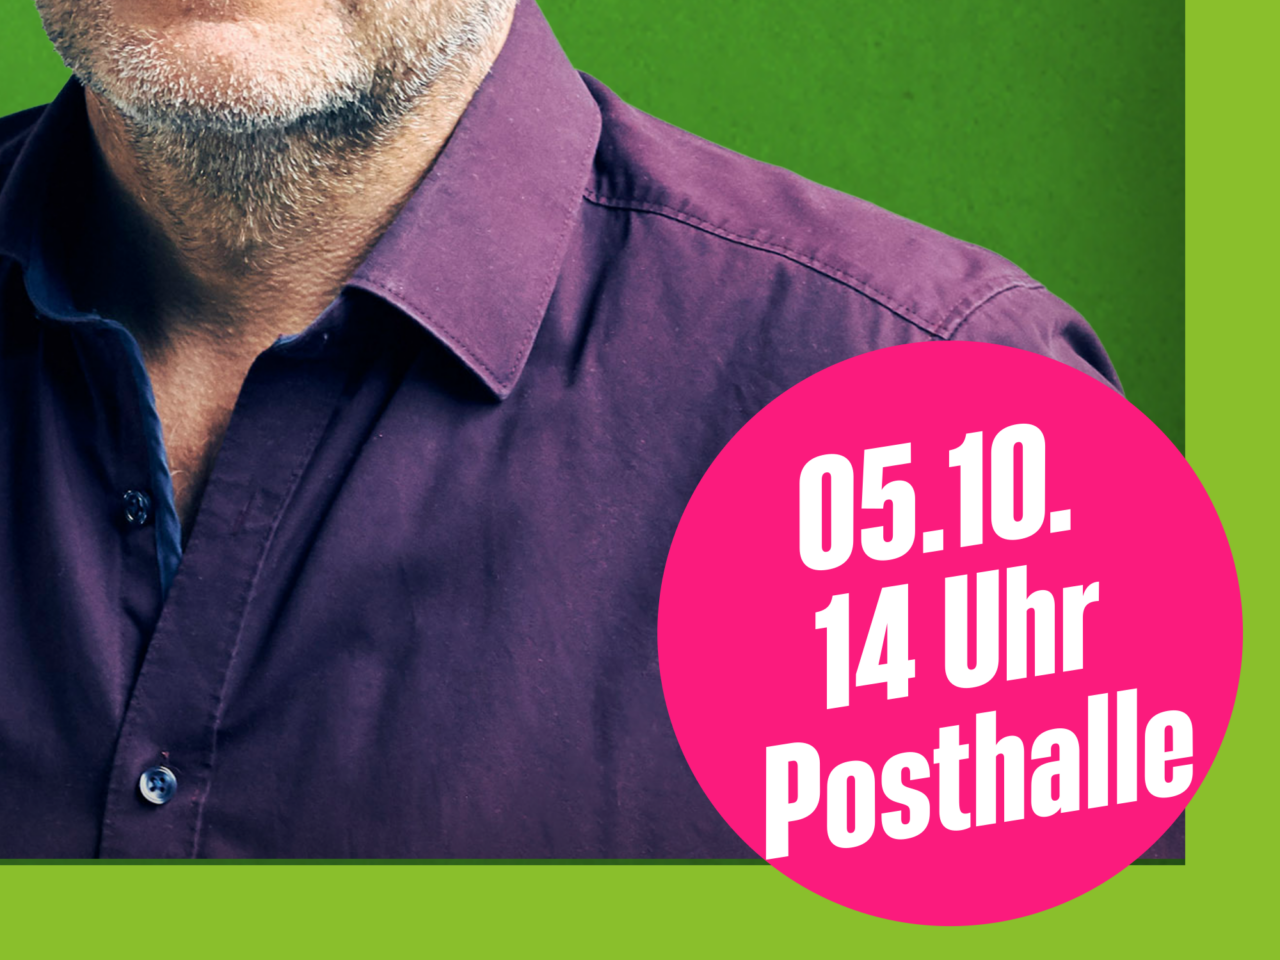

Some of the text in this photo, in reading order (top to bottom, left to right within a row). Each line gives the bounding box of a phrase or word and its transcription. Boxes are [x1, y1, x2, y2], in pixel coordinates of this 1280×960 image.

[799, 423, 1071, 571] 05.10.
[815, 564, 1100, 710] 14 Uhr
[765, 688, 1194, 860] Posthalle
